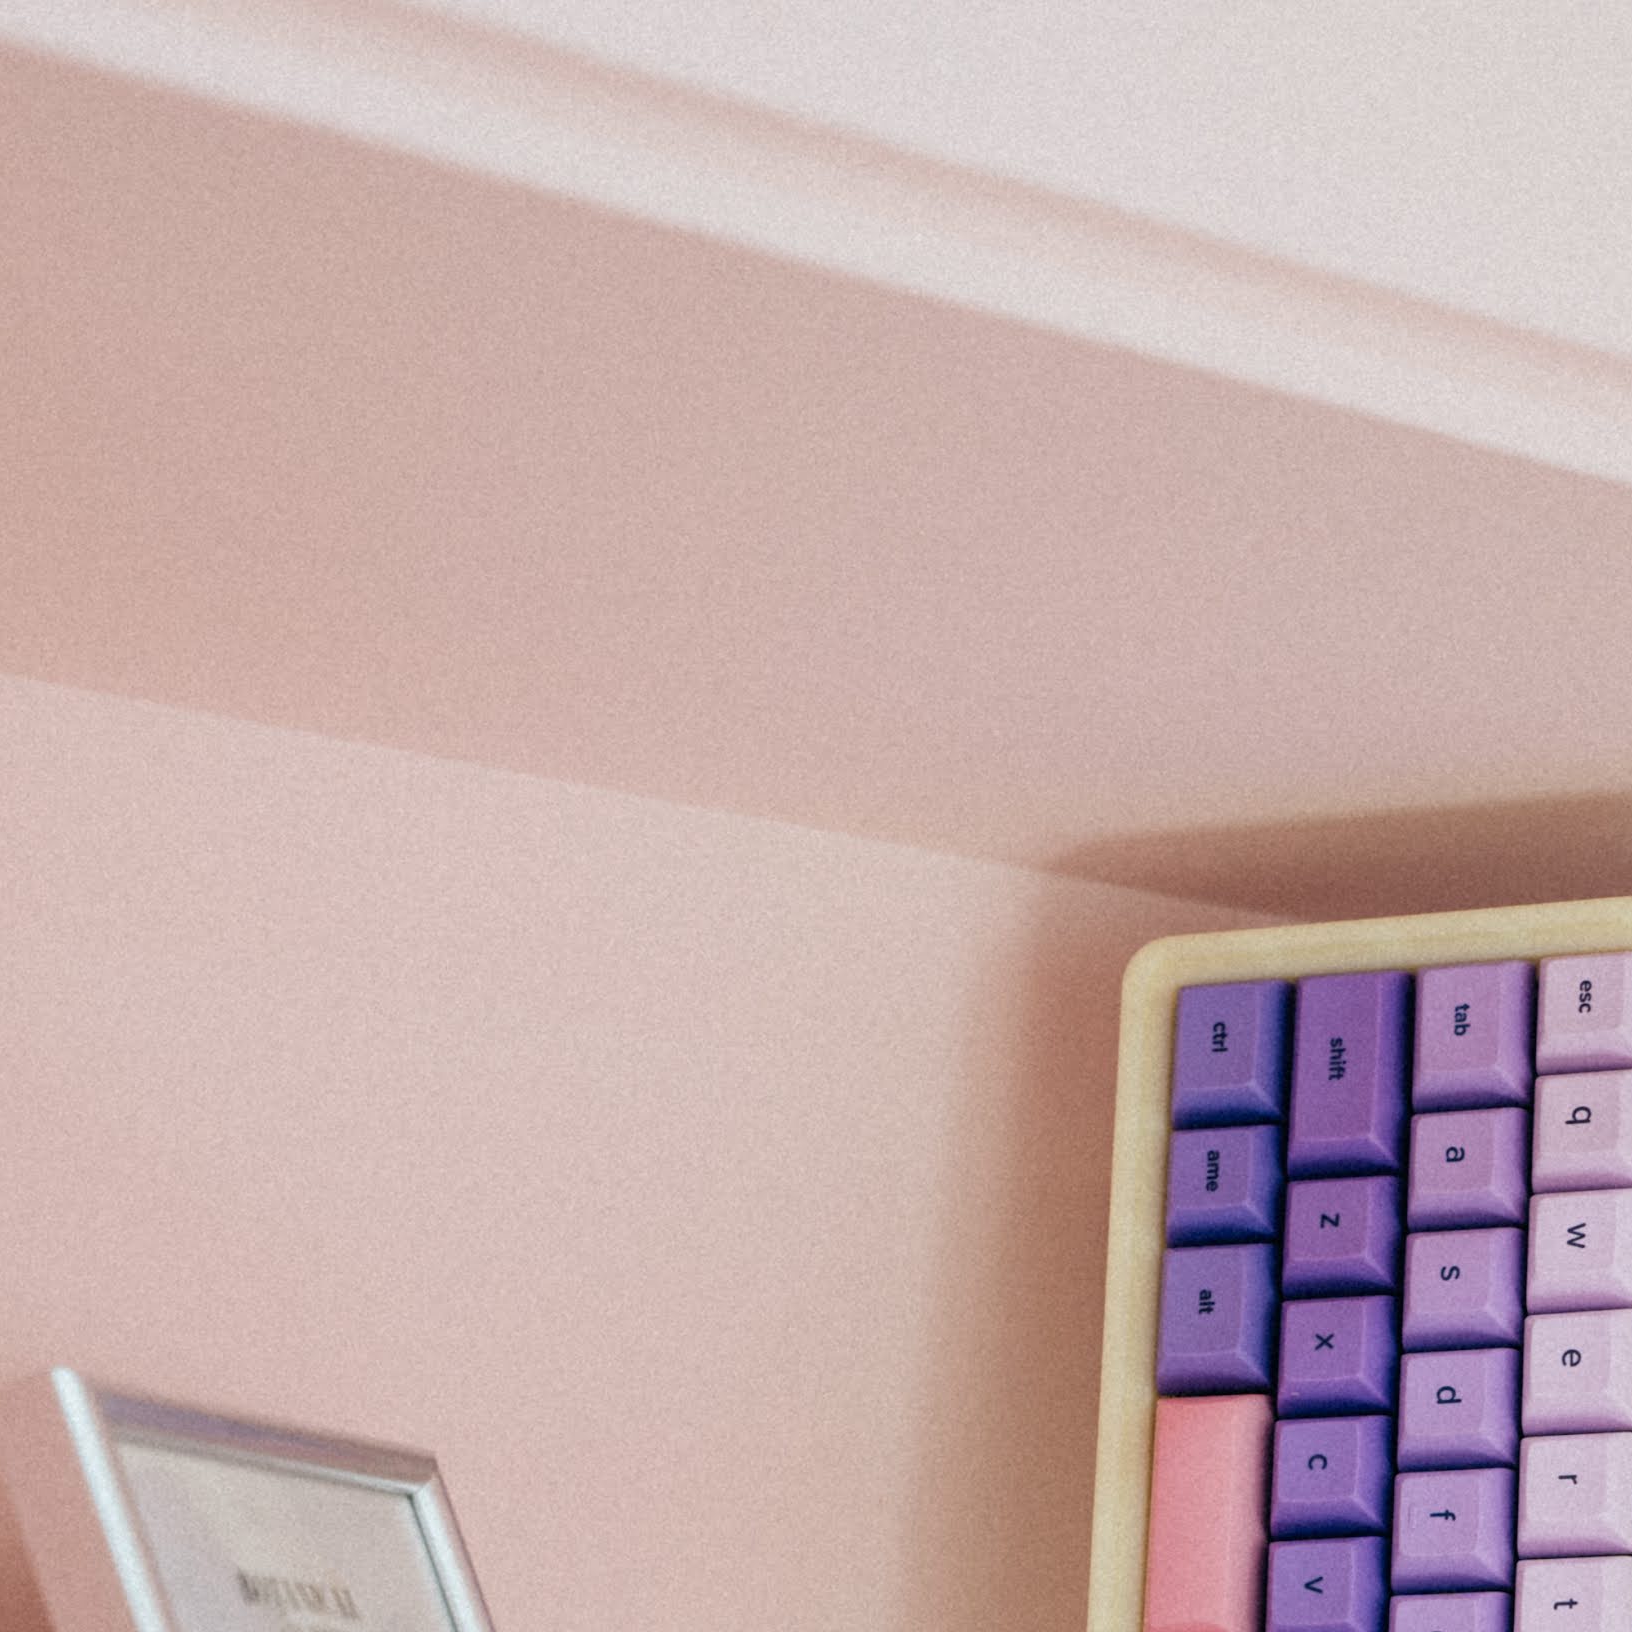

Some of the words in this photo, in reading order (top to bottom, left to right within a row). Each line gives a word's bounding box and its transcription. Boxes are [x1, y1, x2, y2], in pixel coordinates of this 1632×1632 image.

[1576, 978, 1594, 1015] esc
[1452, 1001, 1472, 1038] tab
[1210, 1019, 1230, 1055] ctrl
[1327, 1035, 1348, 1082] shift
[1563, 1104, 1594, 1127] q
[1443, 1144, 1467, 1165] a
[1204, 1148, 1222, 1194] ame
[1318, 1212, 1342, 1230] z
[1565, 1221, 1588, 1250] w
[1438, 1263, 1462, 1283] s
[1196, 1287, 1217, 1316] alt
[1313, 1332, 1336, 1352] x
[1559, 1347, 1583, 1369] e
[1434, 1384, 1464, 1406] d
[1305, 1452, 1330, 1472] c
[1556, 1472, 1579, 1486] r
[1428, 1508, 1458, 1522] f
[1302, 1574, 1325, 1596] v
[1551, 1597, 1580, 1612] t
